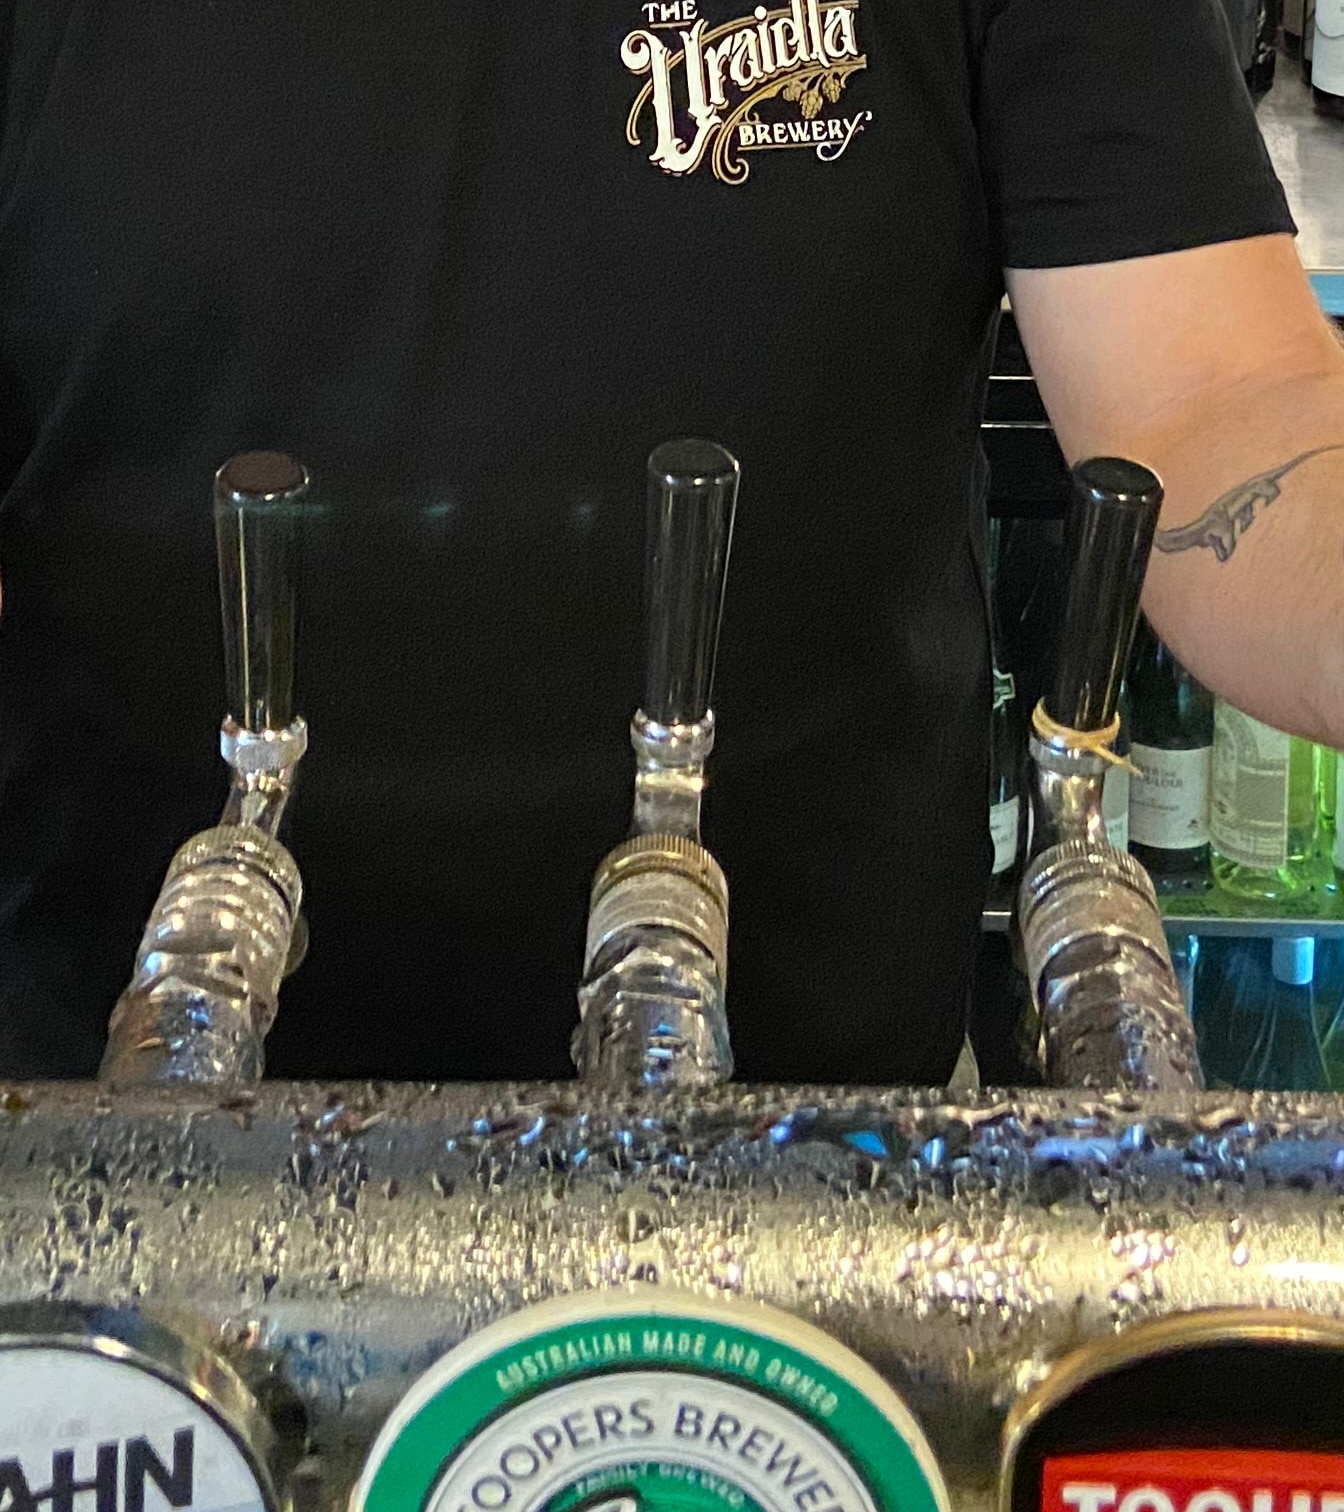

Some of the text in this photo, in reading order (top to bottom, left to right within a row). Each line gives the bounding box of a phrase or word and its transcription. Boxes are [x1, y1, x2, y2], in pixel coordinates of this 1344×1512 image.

[641, 0, 698, 22] THE
[738, 110, 873, 161] BREWERY
[495, 1329, 840, 1418] AUSTRALIAN MADE AND OWNED
